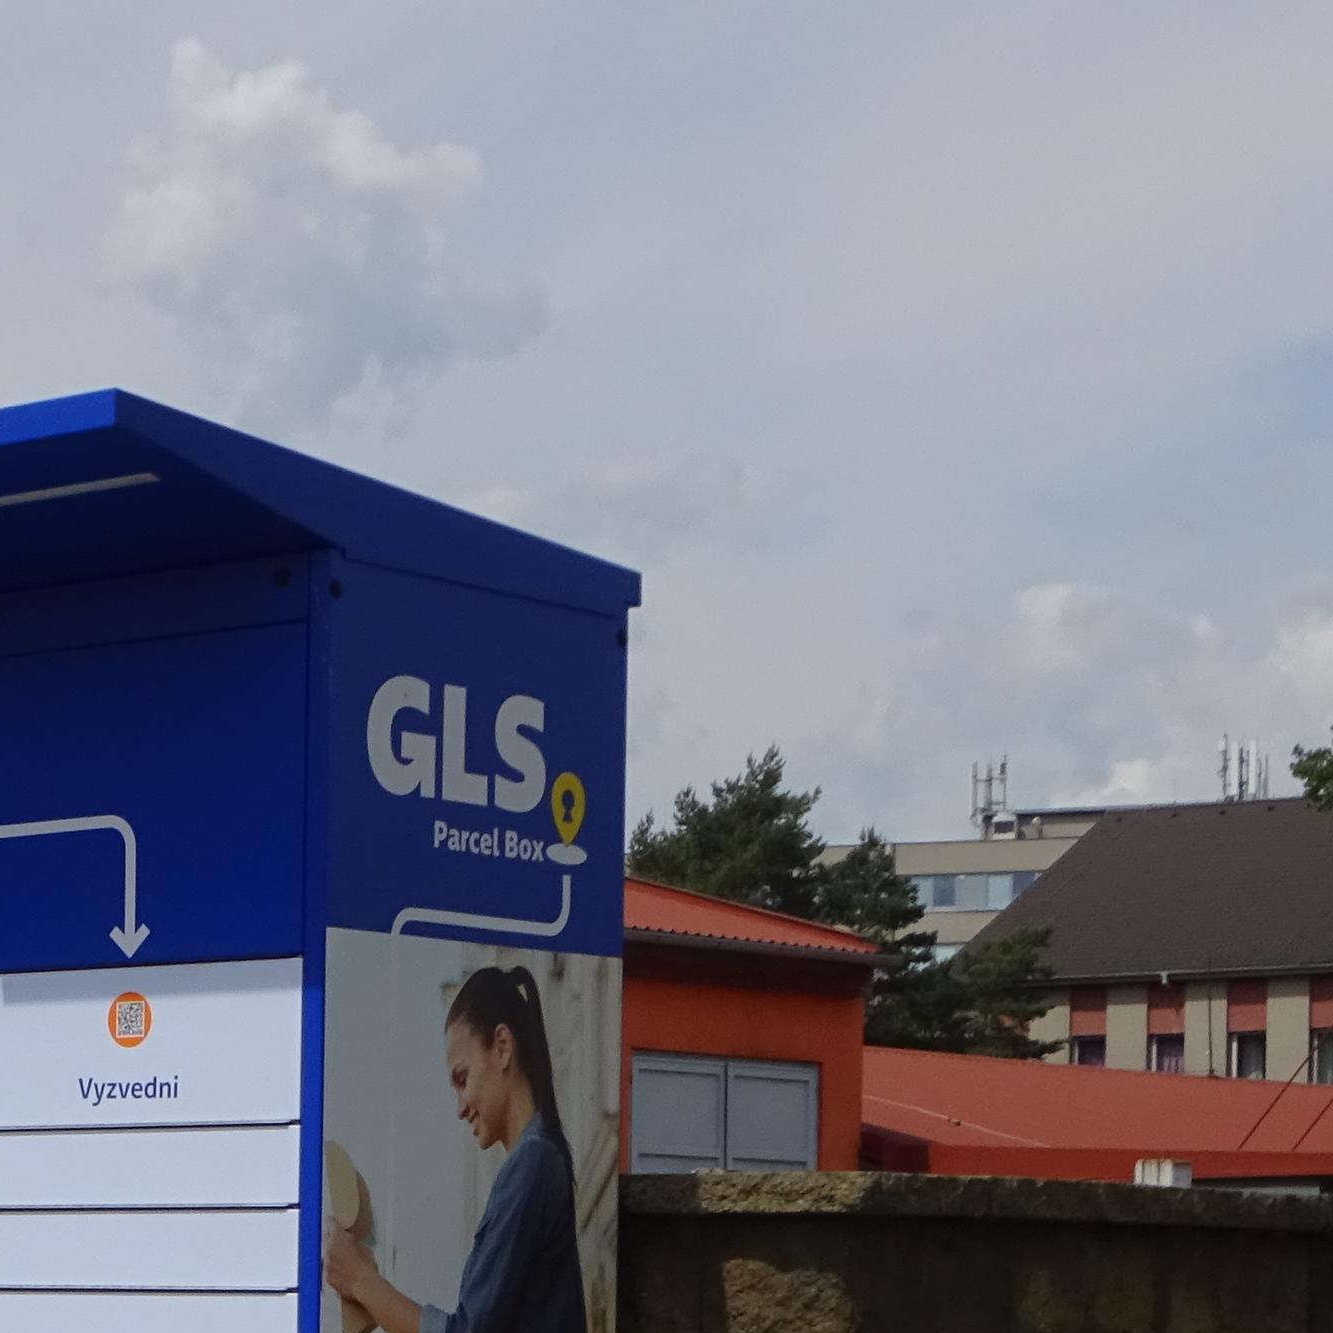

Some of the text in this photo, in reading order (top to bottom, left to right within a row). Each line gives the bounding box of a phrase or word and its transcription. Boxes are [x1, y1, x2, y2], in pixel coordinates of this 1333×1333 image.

[367, 675, 546, 813] GLS
[433, 821, 545, 863] Parcel Box
[78, 1075, 179, 1105] Vyzvedni
